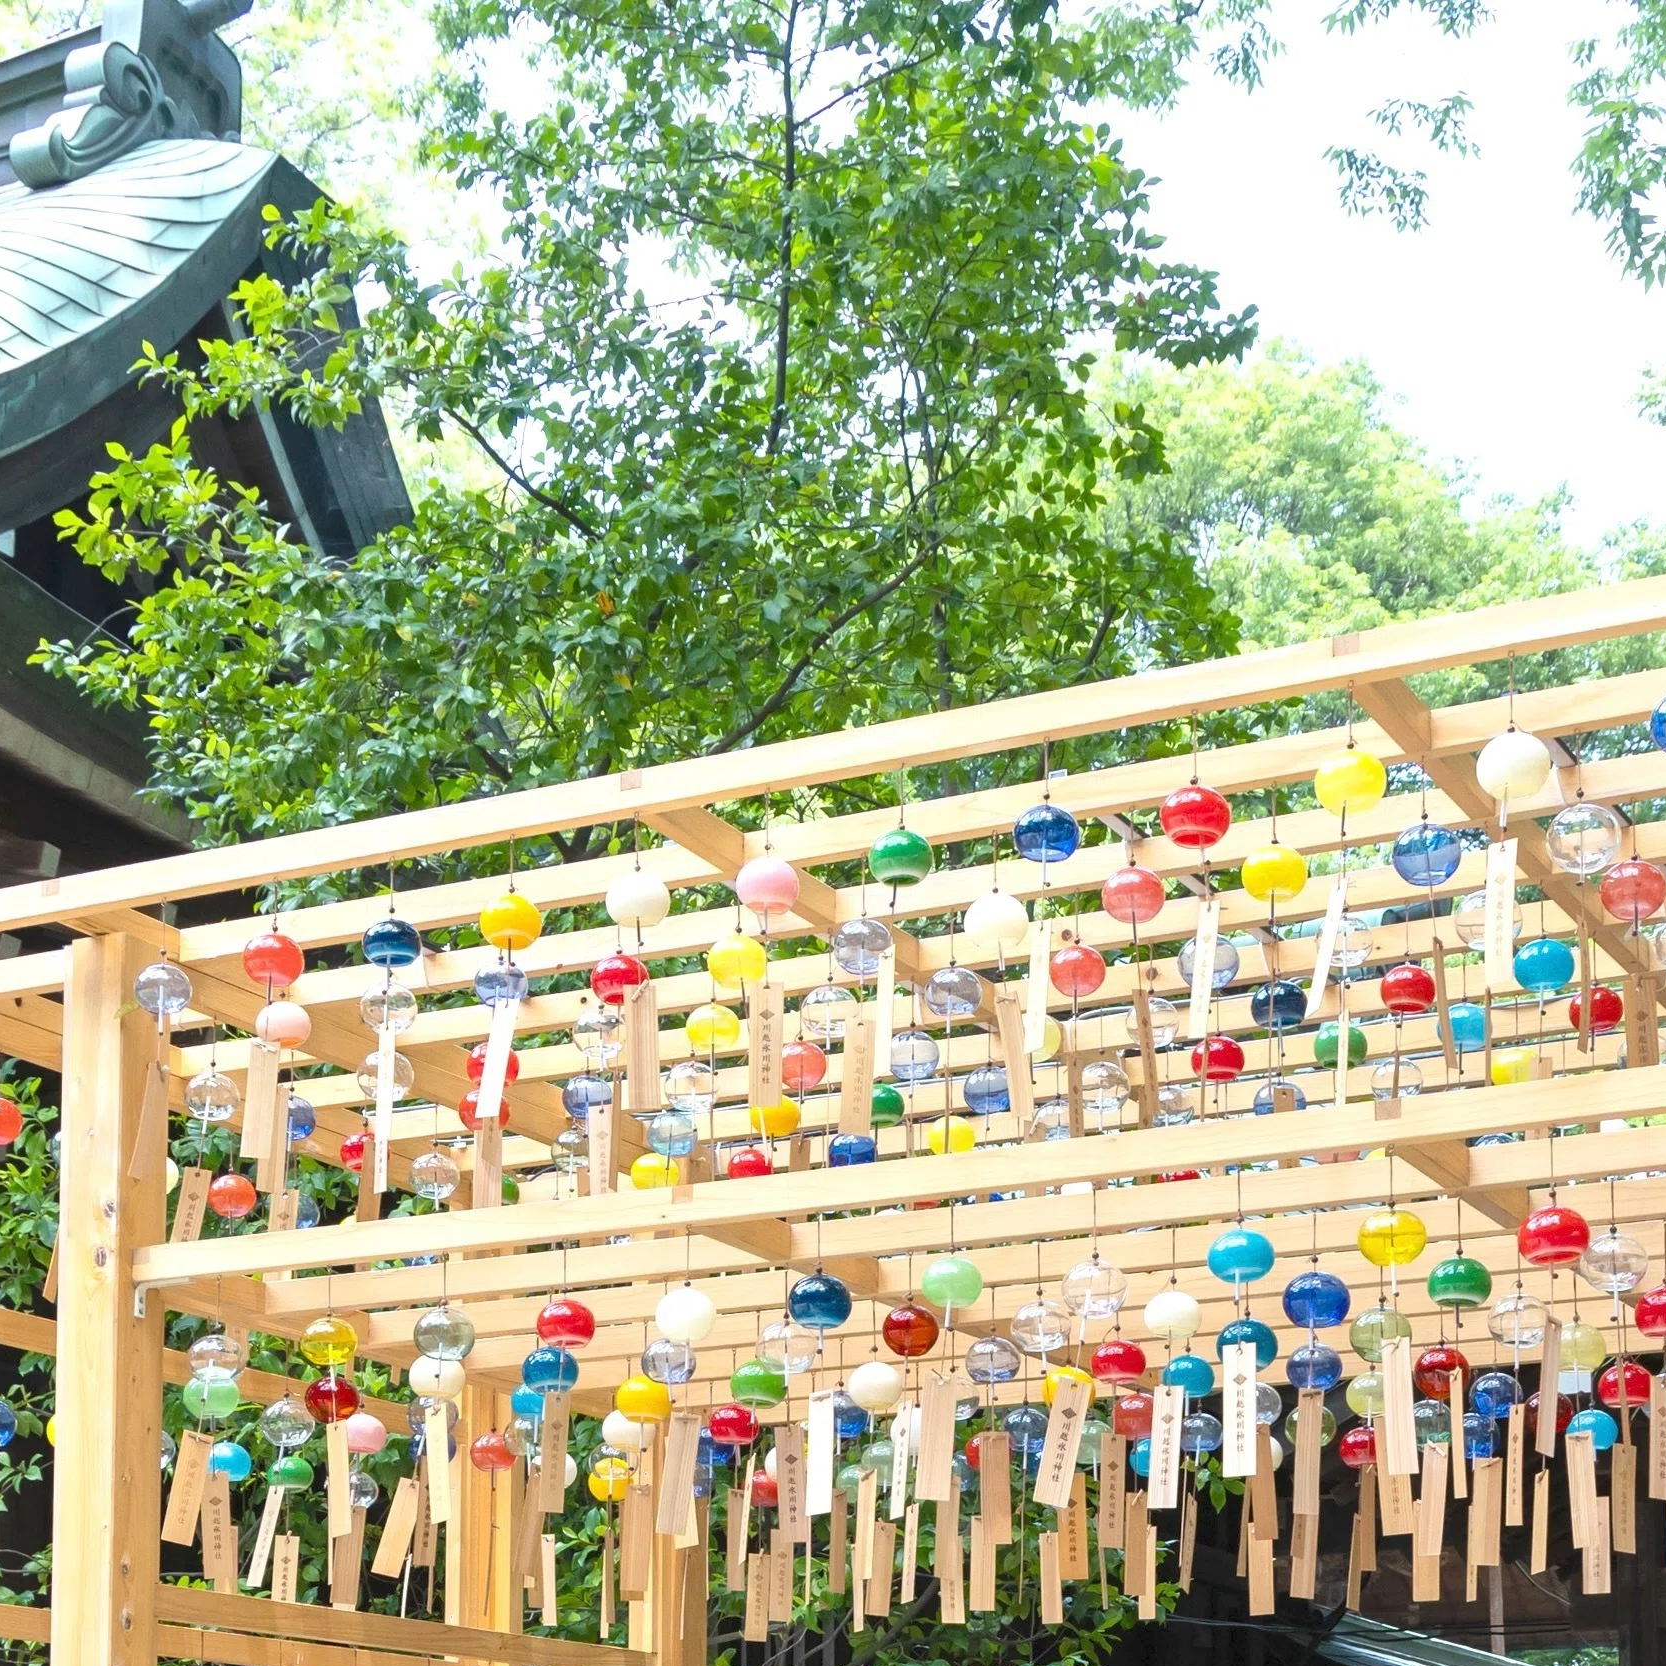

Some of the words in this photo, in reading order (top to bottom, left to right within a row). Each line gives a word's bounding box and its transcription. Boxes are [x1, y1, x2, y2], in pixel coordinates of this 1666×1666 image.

[761, 1023, 772, 1084] 川越氷川神社
[1236, 1387, 1246, 1453] 川越氷川神社
[1052, 1421, 1071, 1483] 川越氷川神社
[1160, 1427, 1172, 1487] 川越氷川神社
[788, 1466, 797, 1524] 川越氷川神社
[1108, 1473, 1117, 1530] 川越氷川神社
[212, 1507, 223, 1561] 川越氷川神社
